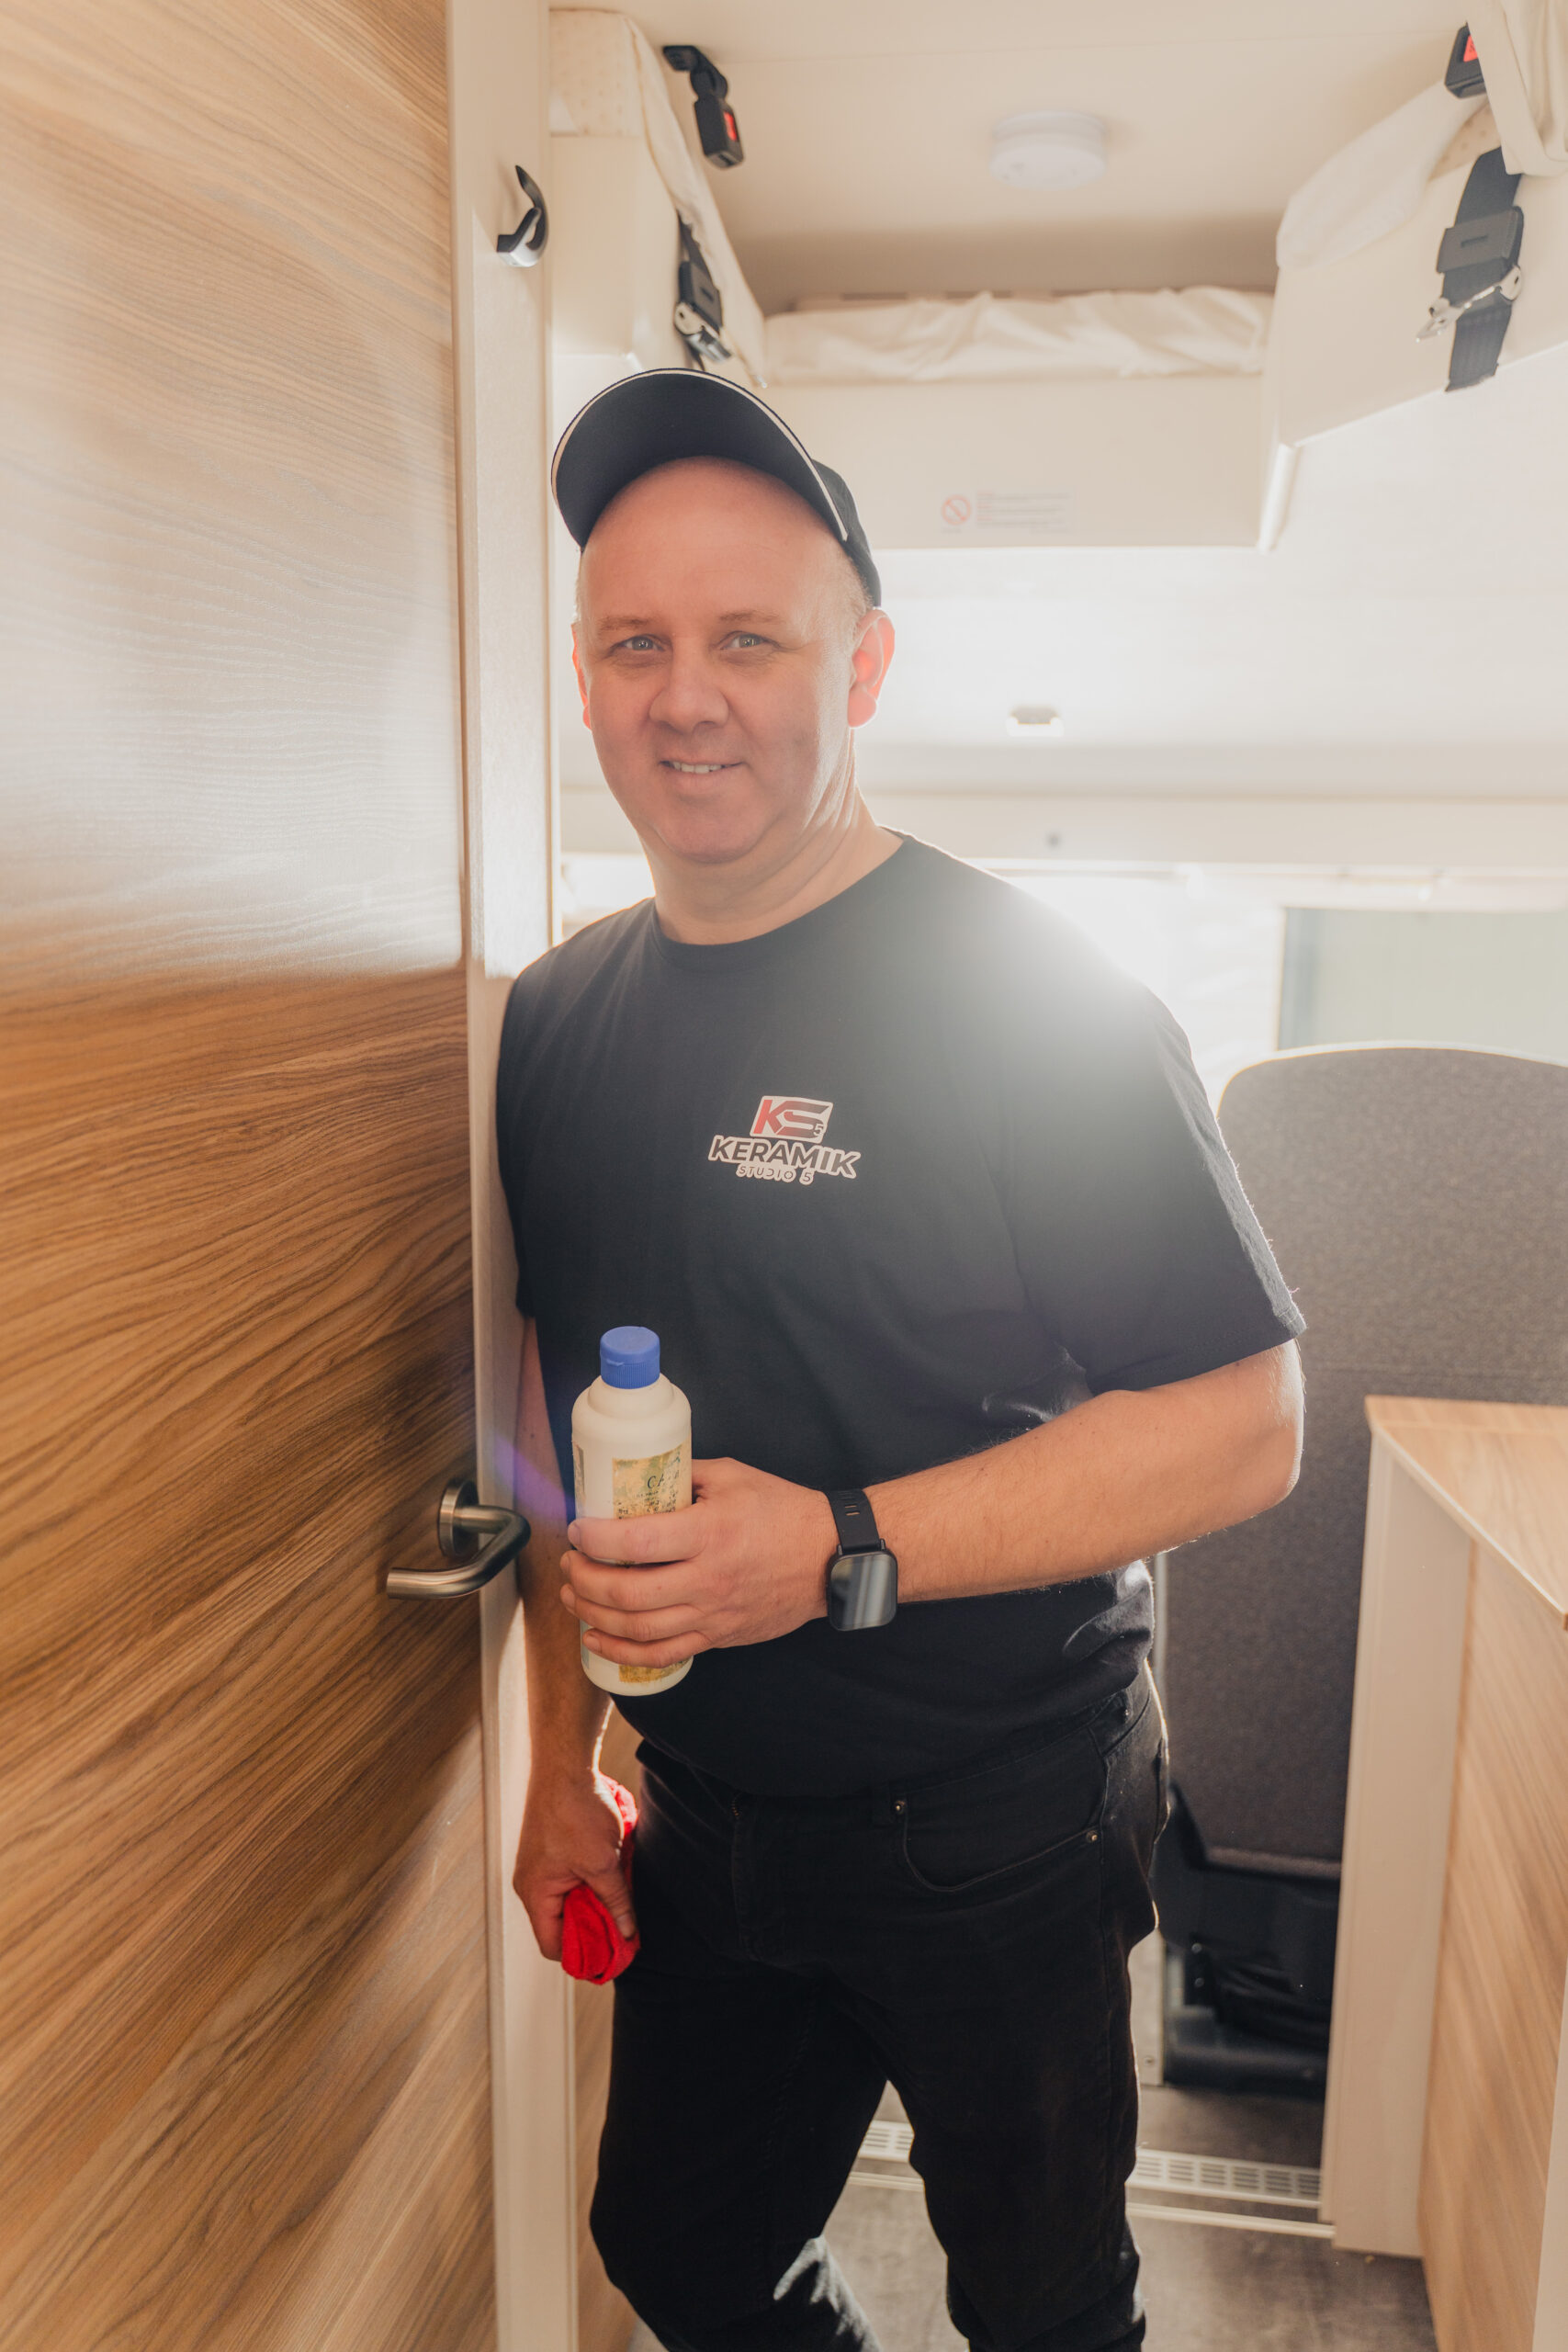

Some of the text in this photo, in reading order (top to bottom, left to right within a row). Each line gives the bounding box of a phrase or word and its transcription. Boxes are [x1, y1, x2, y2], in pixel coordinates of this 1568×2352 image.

[710, 1136, 859, 1177] KERAMIK
[738, 1165, 812, 1183] STUDIO 5
